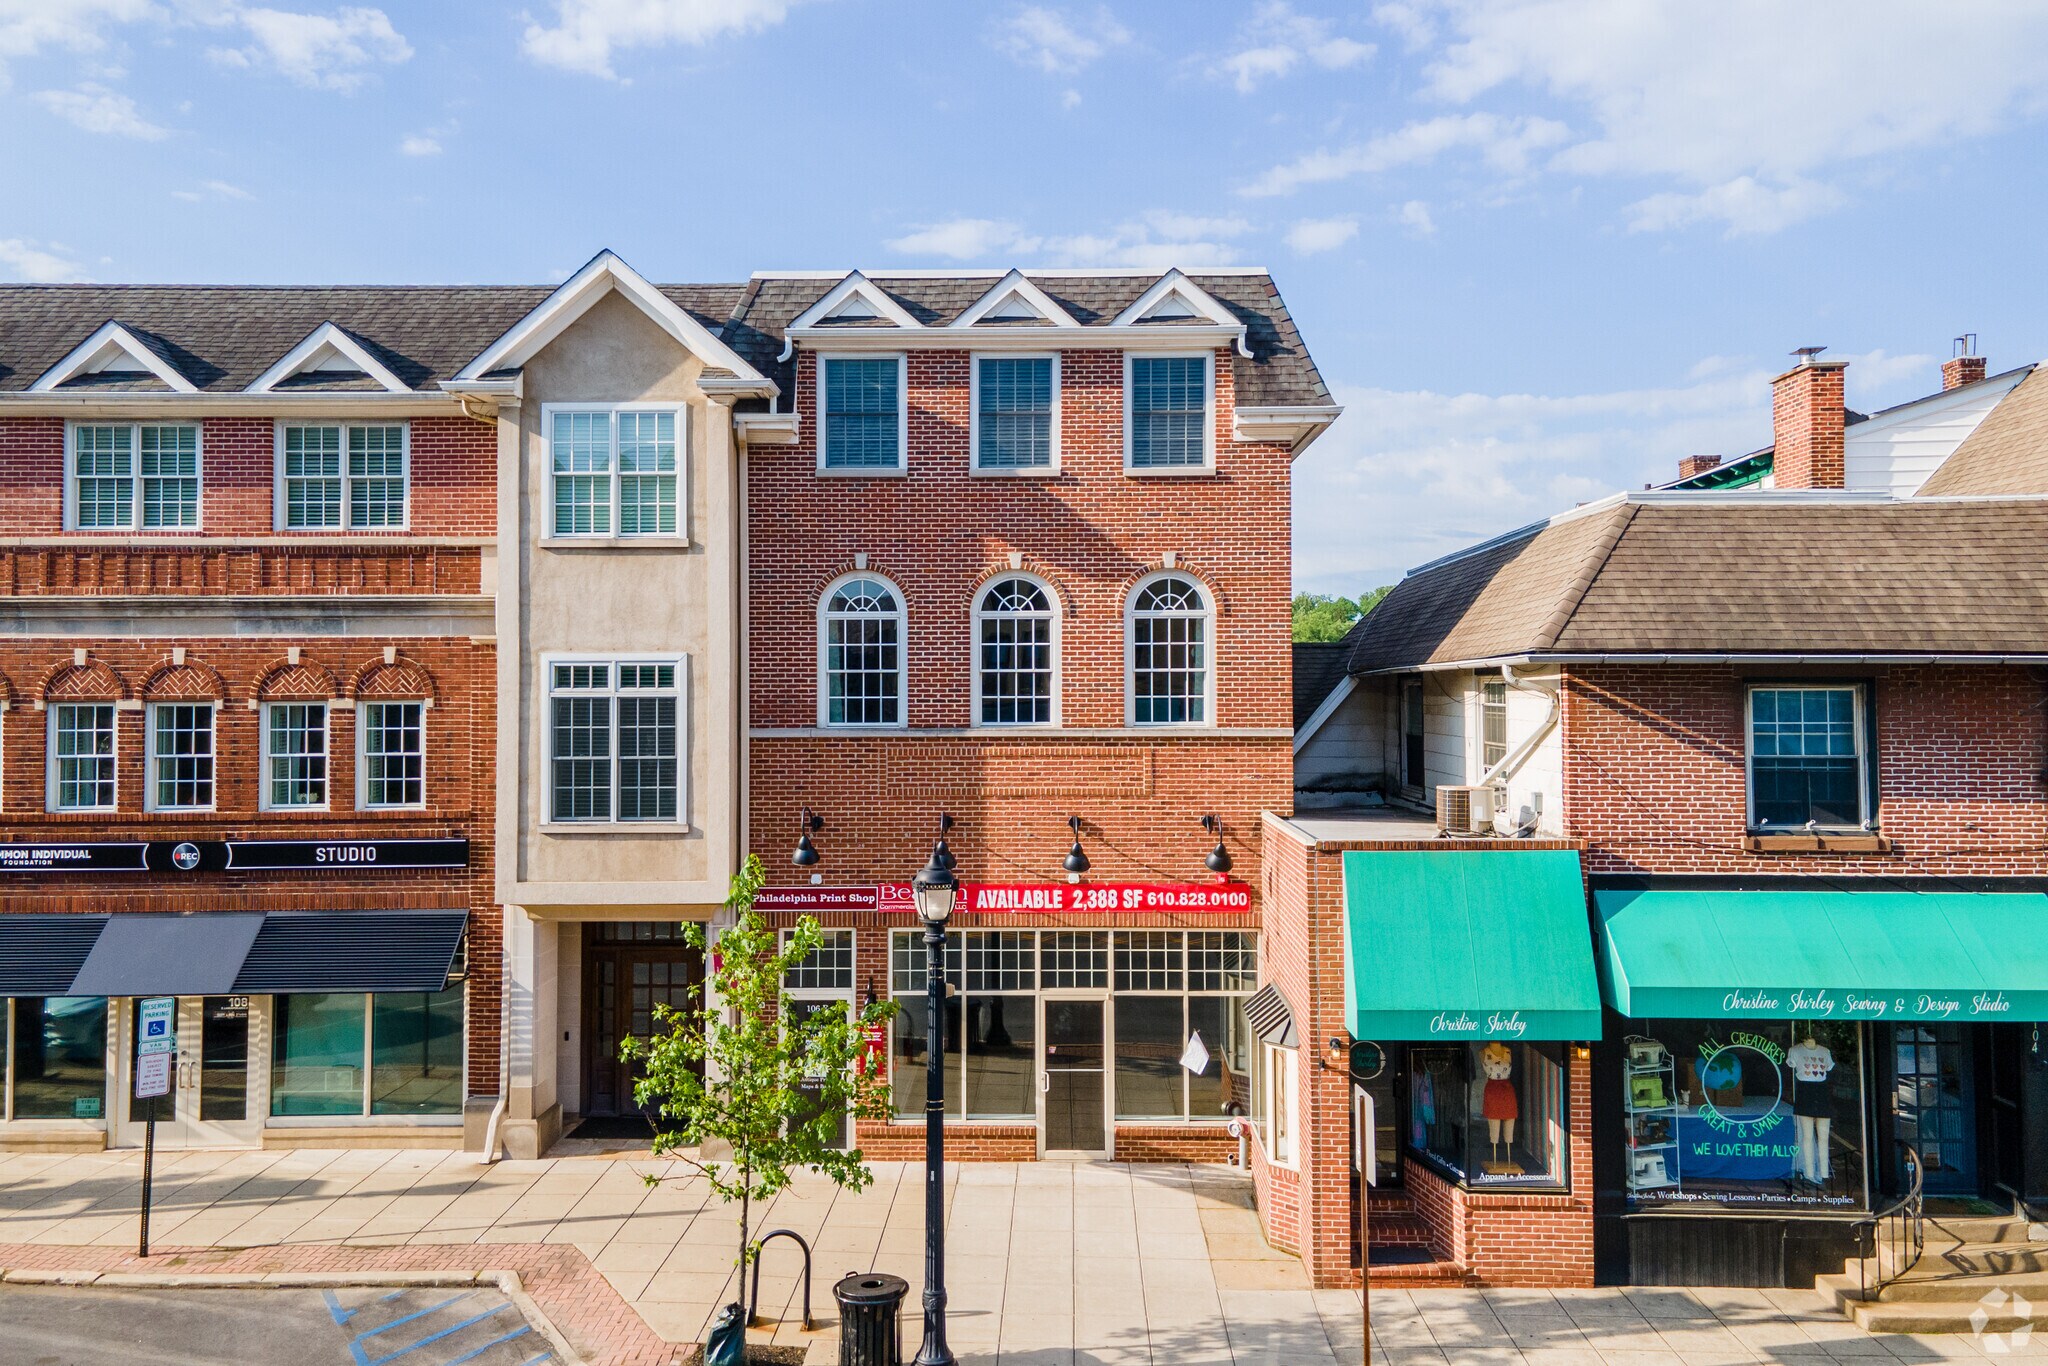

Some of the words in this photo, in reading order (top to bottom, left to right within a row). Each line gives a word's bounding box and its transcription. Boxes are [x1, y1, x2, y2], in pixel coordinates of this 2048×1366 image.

[32, 849, 91, 858] INDIVIDUAL
[316, 847, 376, 861] STUDIO
[753, 894, 817, 904] Philadelphia
[820, 894, 846, 902] Print
[849, 894, 875, 904] Shop
[977, 890, 1063, 909] AVAILABLE
[1073, 889, 1118, 911] 2,388
[1123, 889, 1143, 909] SF
[1147, 892, 1248, 906] 610.828.0100
[143, 1001, 172, 1010] RESERVED
[228, 997, 248, 1007] 108
[1723, 989, 1780, 1011] Christine
[1787, 989, 1835, 1018] Shirley
[1842, 994, 1888, 1018] Sewing
[1894, 998, 1905, 1013] &
[1912, 994, 1961, 1019] Design
[1969, 991, 2011, 1015] Studio
[144, 1010, 170, 1018] PARKING
[1430, 1011, 1480, 1033] Christine
[1484, 1011, 1527, 1038] Shirley
[1698, 1037, 1725, 1061] ALL
[1730, 1031, 1786, 1065] CREATURES
[1698, 1103, 1735, 1135] GREAT
[1737, 1122, 1747, 1138] &
[1752, 1111, 1784, 1138] SMALL
[1693, 1142, 1711, 1156] WE
[1715, 1143, 1742, 1156] LOVE
[1742, 1143, 1769, 1157] THEM
[1771, 1145, 1791, 1158] ALL
[1479, 1172, 1508, 1182] Apparel
[1516, 1172, 1556, 1180] Accessories
[1656, 1190, 1697, 1202] Workshops
[1702, 1192, 1728, 1203] Sewing
[1728, 1192, 1757, 1201] Lessons
[1761, 1193, 1787, 1202] Parties
[1790, 1193, 1817, 1205] Camps
[1822, 1194, 1855, 1206] Supplies
